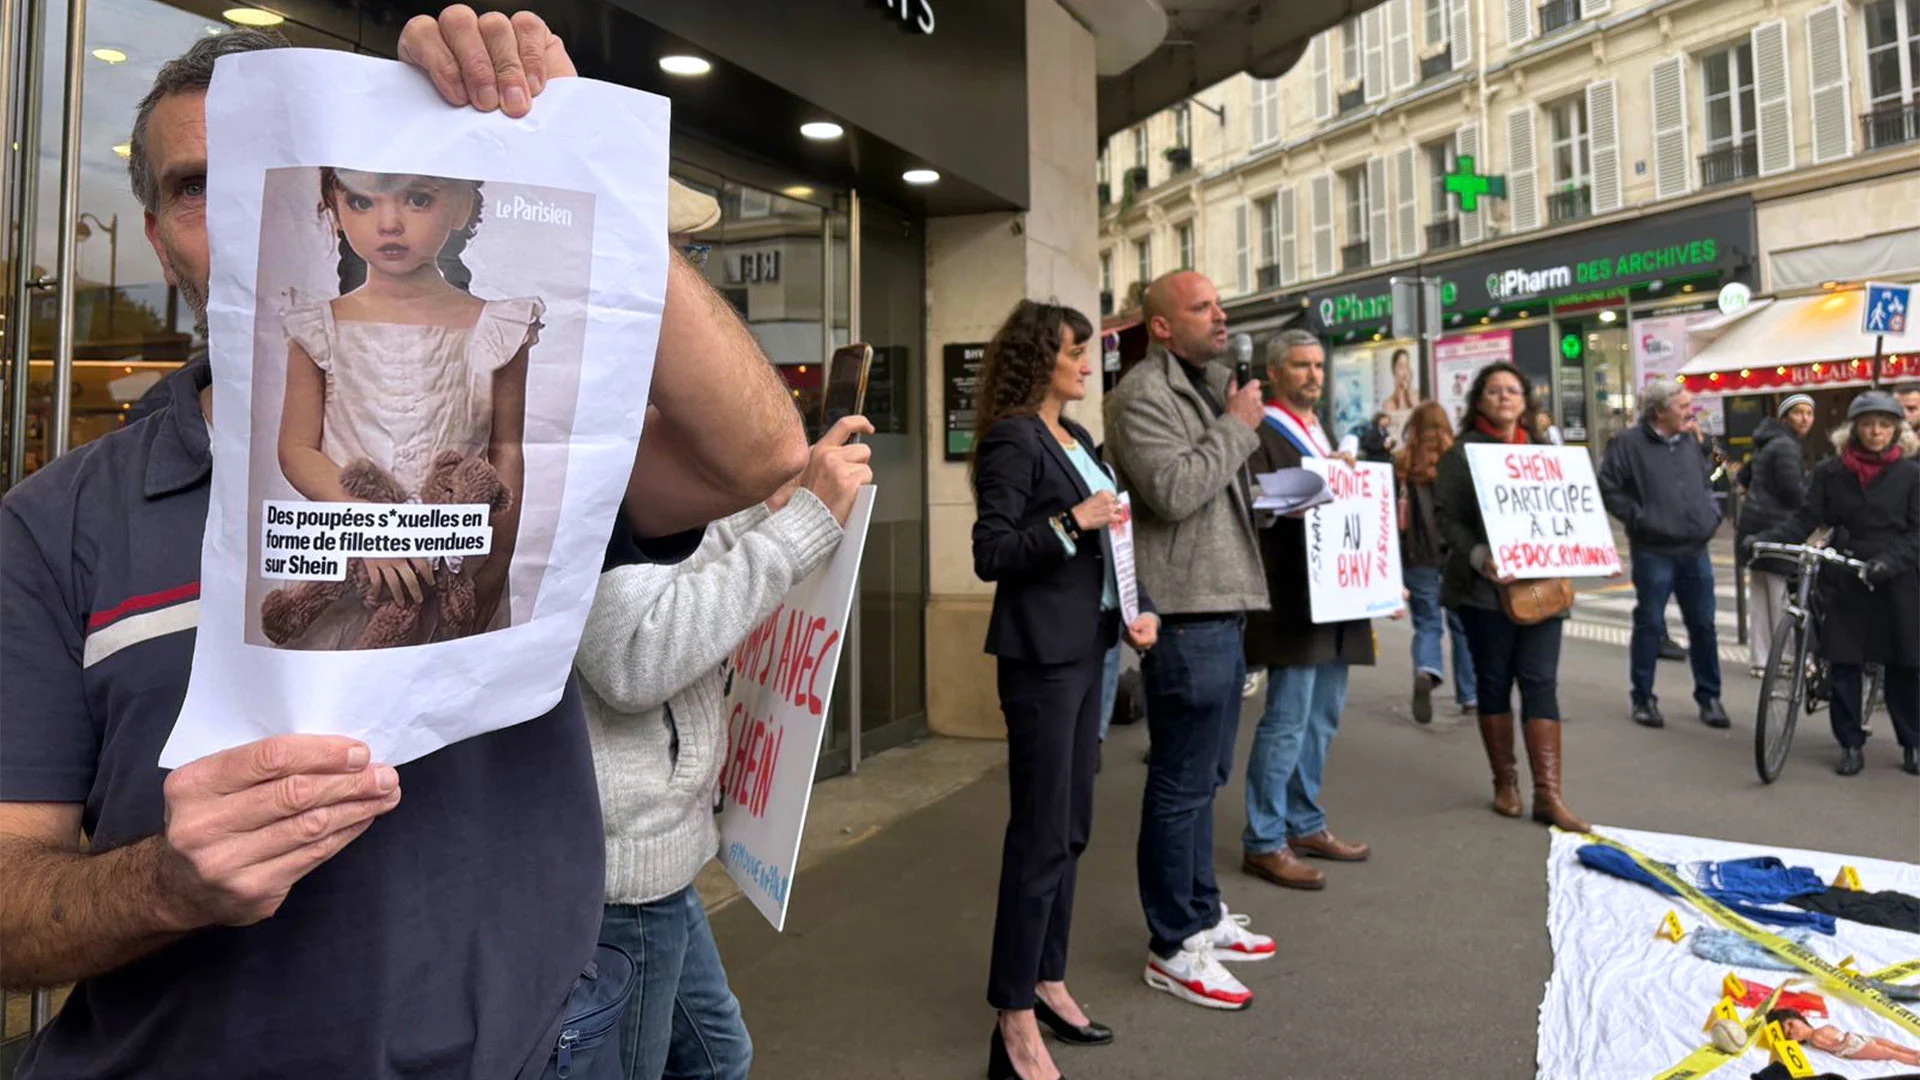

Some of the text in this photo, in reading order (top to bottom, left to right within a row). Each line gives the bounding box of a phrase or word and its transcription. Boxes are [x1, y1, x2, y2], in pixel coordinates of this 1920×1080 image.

[496, 195, 572, 227] Le Parisien
[1500, 265, 1571, 297] iPharm
[1577, 258, 1612, 284] DES
[1616, 239, 1717, 276] ARCHIVES
[1328, 464, 1372, 499] HONTE
[1494, 484, 1594, 515] PARTICIPE
[267, 506, 294, 525] Des
[296, 508, 375, 530] poupées
[462, 513, 482, 527] en
[1343, 513, 1361, 551] AU
[1551, 516, 1573, 537] LA
[266, 530, 484, 551] forme de fillettes vendues
[265, 555, 338, 575] sur Shein
[1337, 550, 1371, 588] BHV
[773, 609, 839, 715] AVEC
[1786, 1045, 1804, 1069] 6
